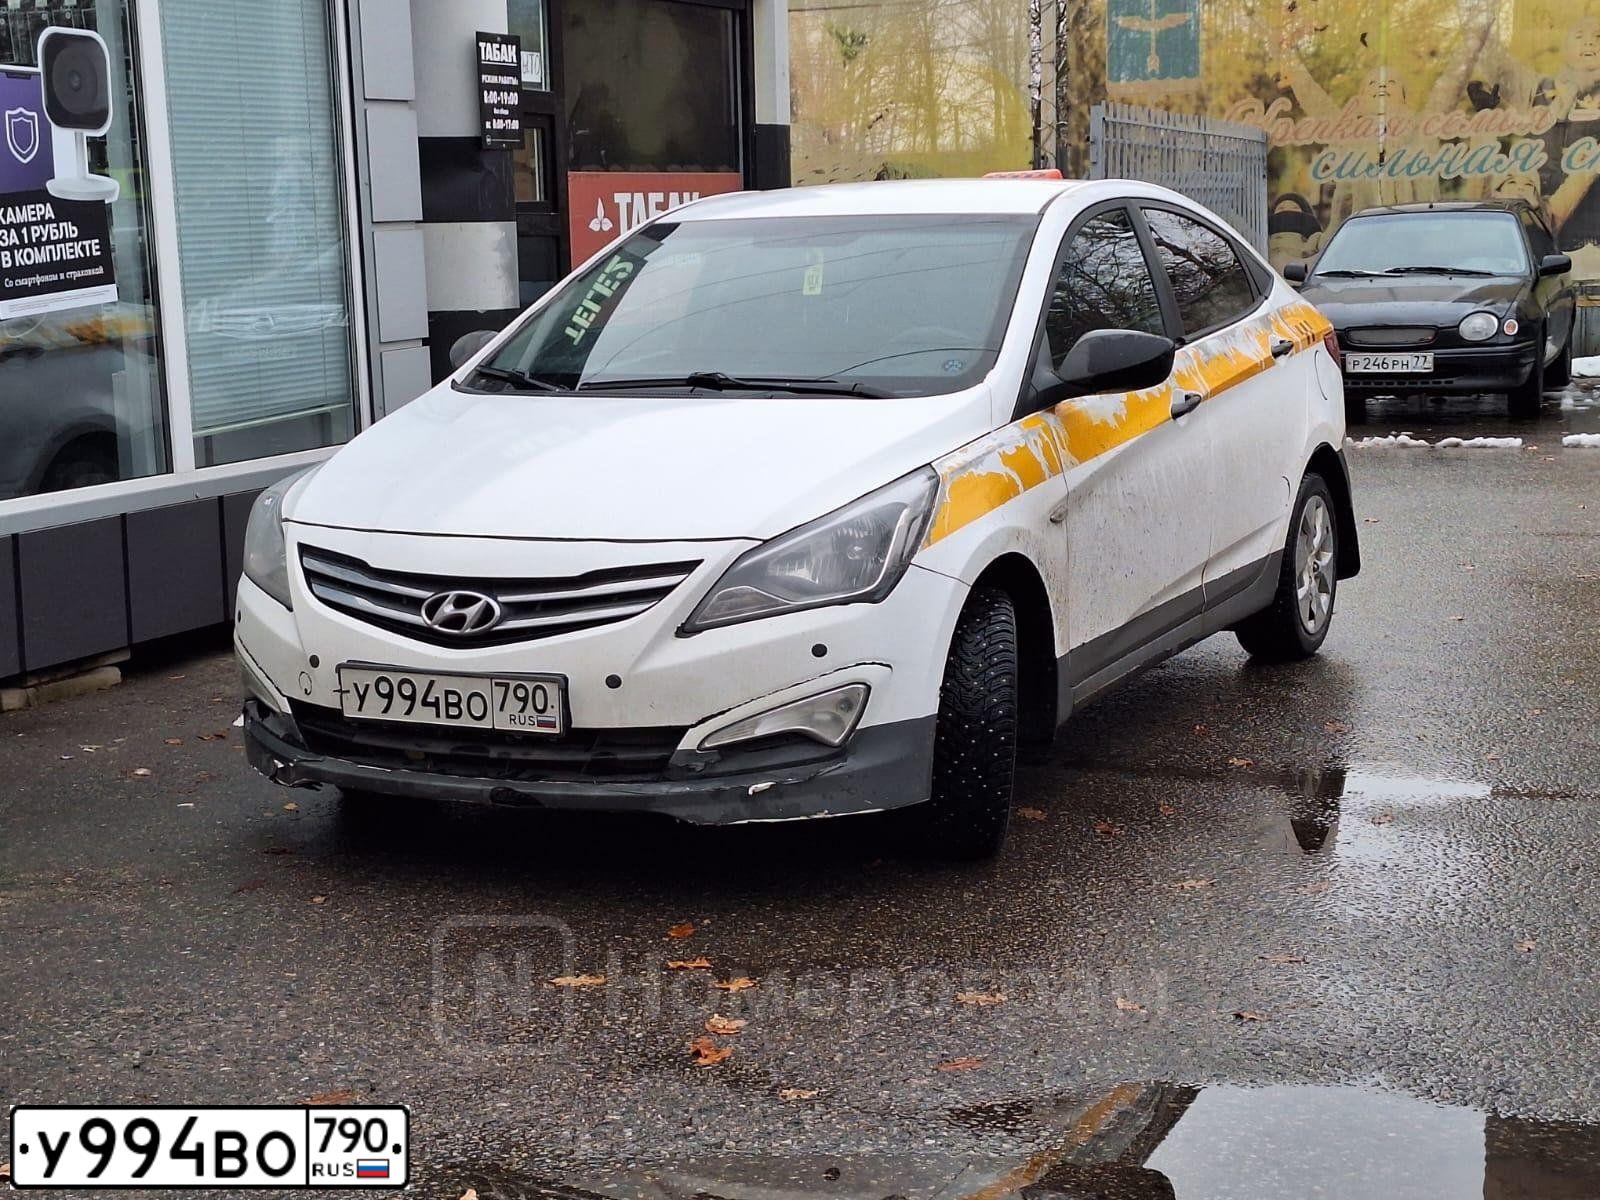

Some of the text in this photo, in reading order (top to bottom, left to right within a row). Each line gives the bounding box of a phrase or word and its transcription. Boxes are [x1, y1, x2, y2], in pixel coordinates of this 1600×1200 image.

[479, 42, 517, 63] ТАБАК
[614, 192, 700, 236] ТАБ
[0, 221, 78, 247] ЗА 1 РУБЛЬ
[1, 239, 101, 268] В КОМПЛЕКТЕ
[5, 278, 14, 288] Со
[15, 273, 58, 287] смартфоном
[66, 265, 104, 281] страховкой
[353, 675, 549, 722] У994ВО 790
[509, 714, 536, 726] RUS
